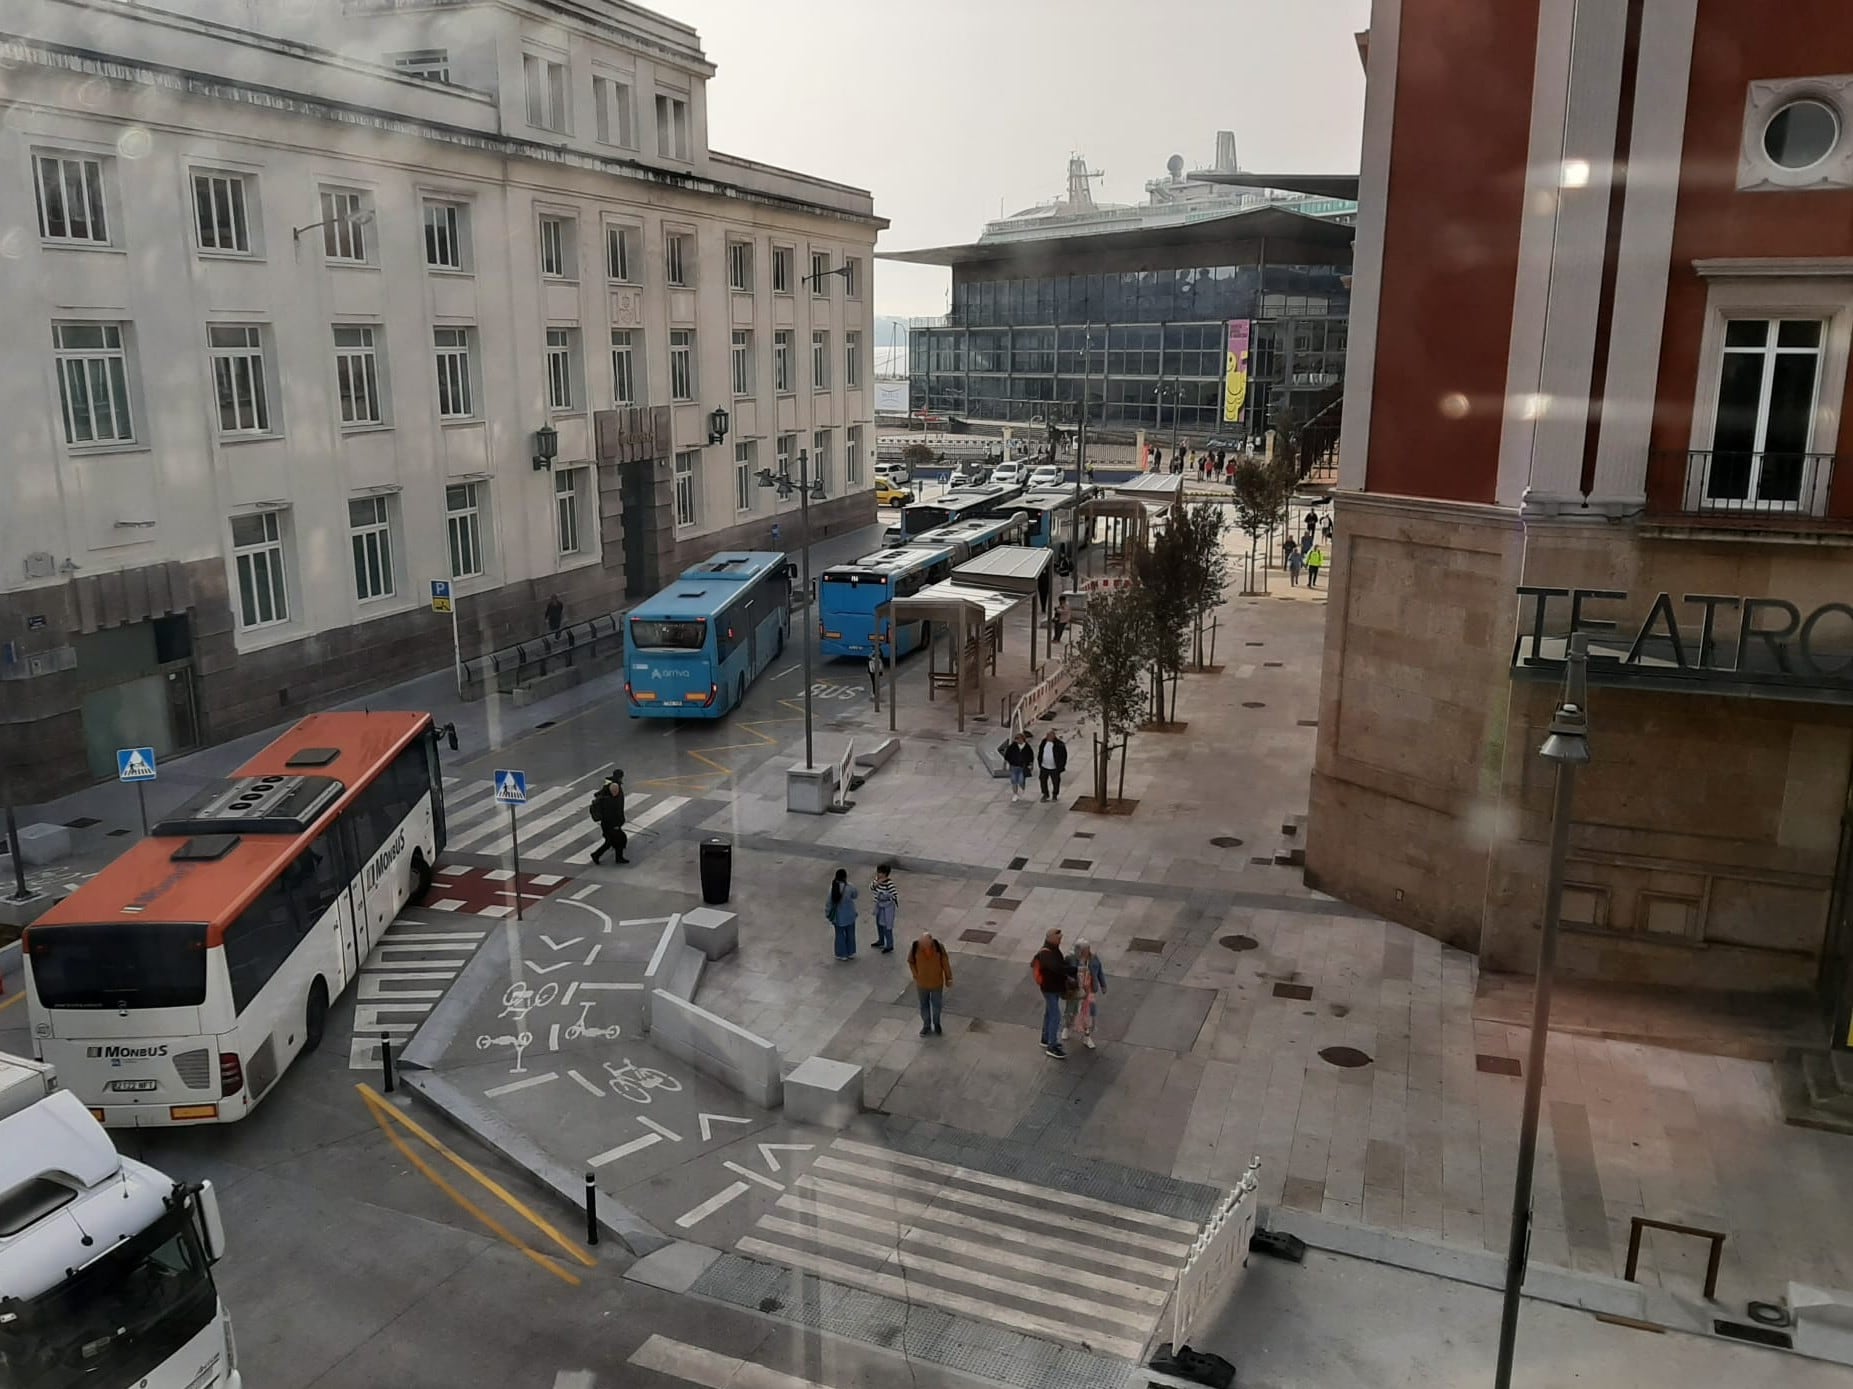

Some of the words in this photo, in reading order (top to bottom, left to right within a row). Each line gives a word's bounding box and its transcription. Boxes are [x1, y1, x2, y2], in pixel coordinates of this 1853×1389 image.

[436, 583, 445, 595] P
[1516, 587, 1853, 674] TEATRO
[797, 683, 865, 699] BUS
[105, 1045, 168, 1058] MONBUS
